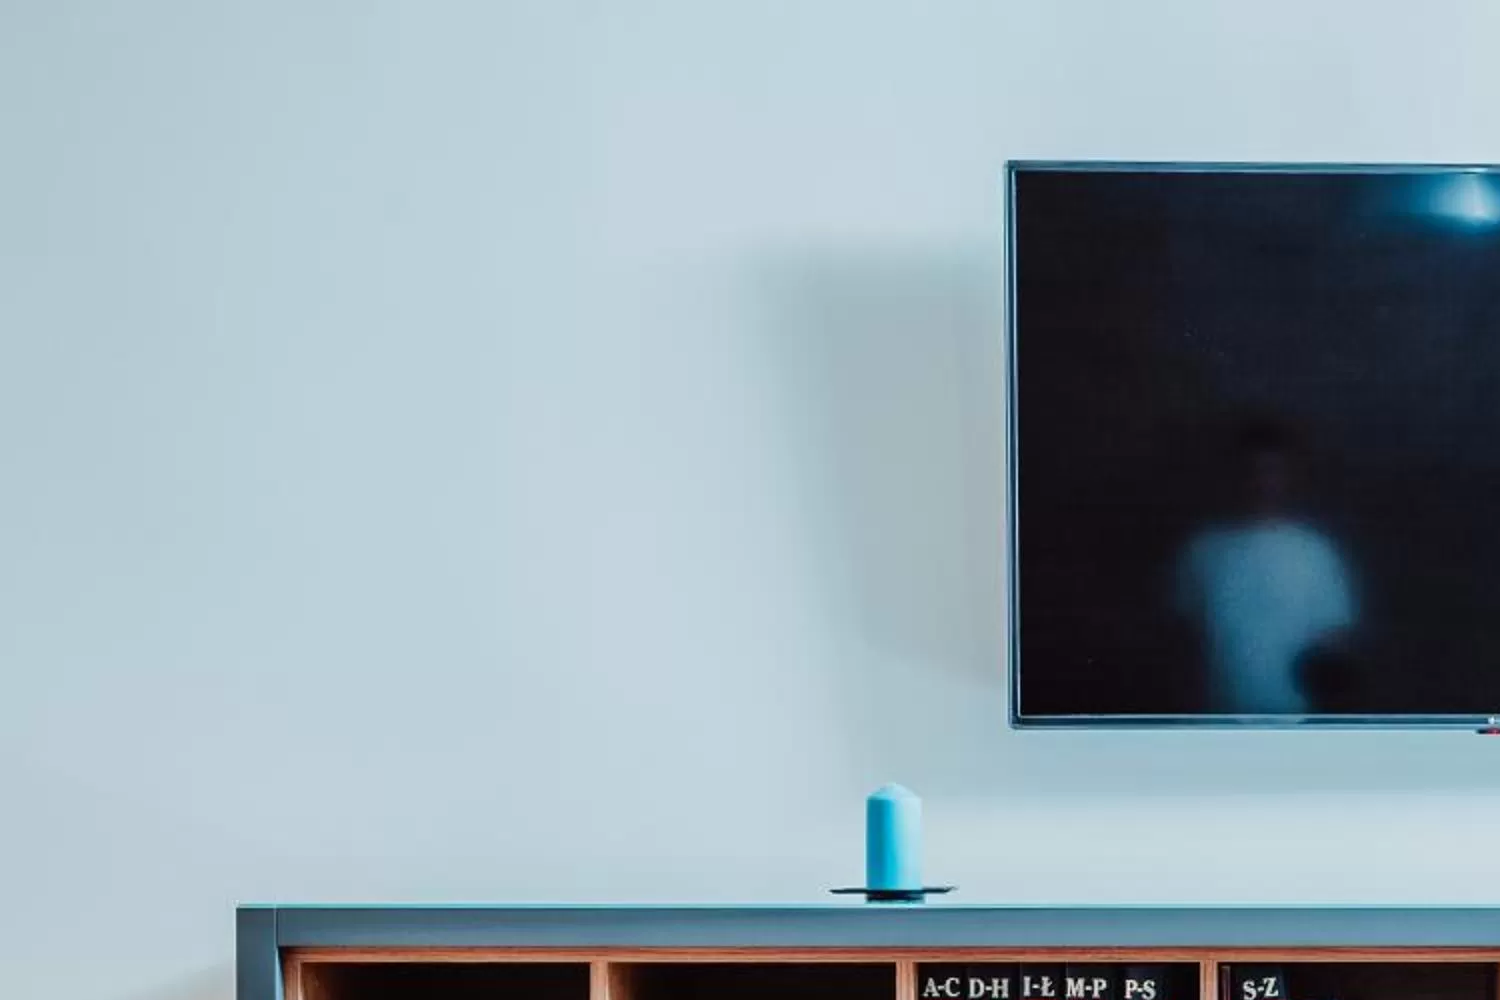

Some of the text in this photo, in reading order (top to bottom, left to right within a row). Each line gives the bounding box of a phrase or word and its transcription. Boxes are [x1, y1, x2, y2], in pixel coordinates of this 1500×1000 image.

[923, 978, 960, 998] A-C
[968, 977, 1009, 999] D-H
[1023, 976, 1055, 998] I-Ł
[1066, 978, 1107, 998] M-P
[1124, 979, 1157, 1000] P-S
[1242, 976, 1279, 1000] S-Z
